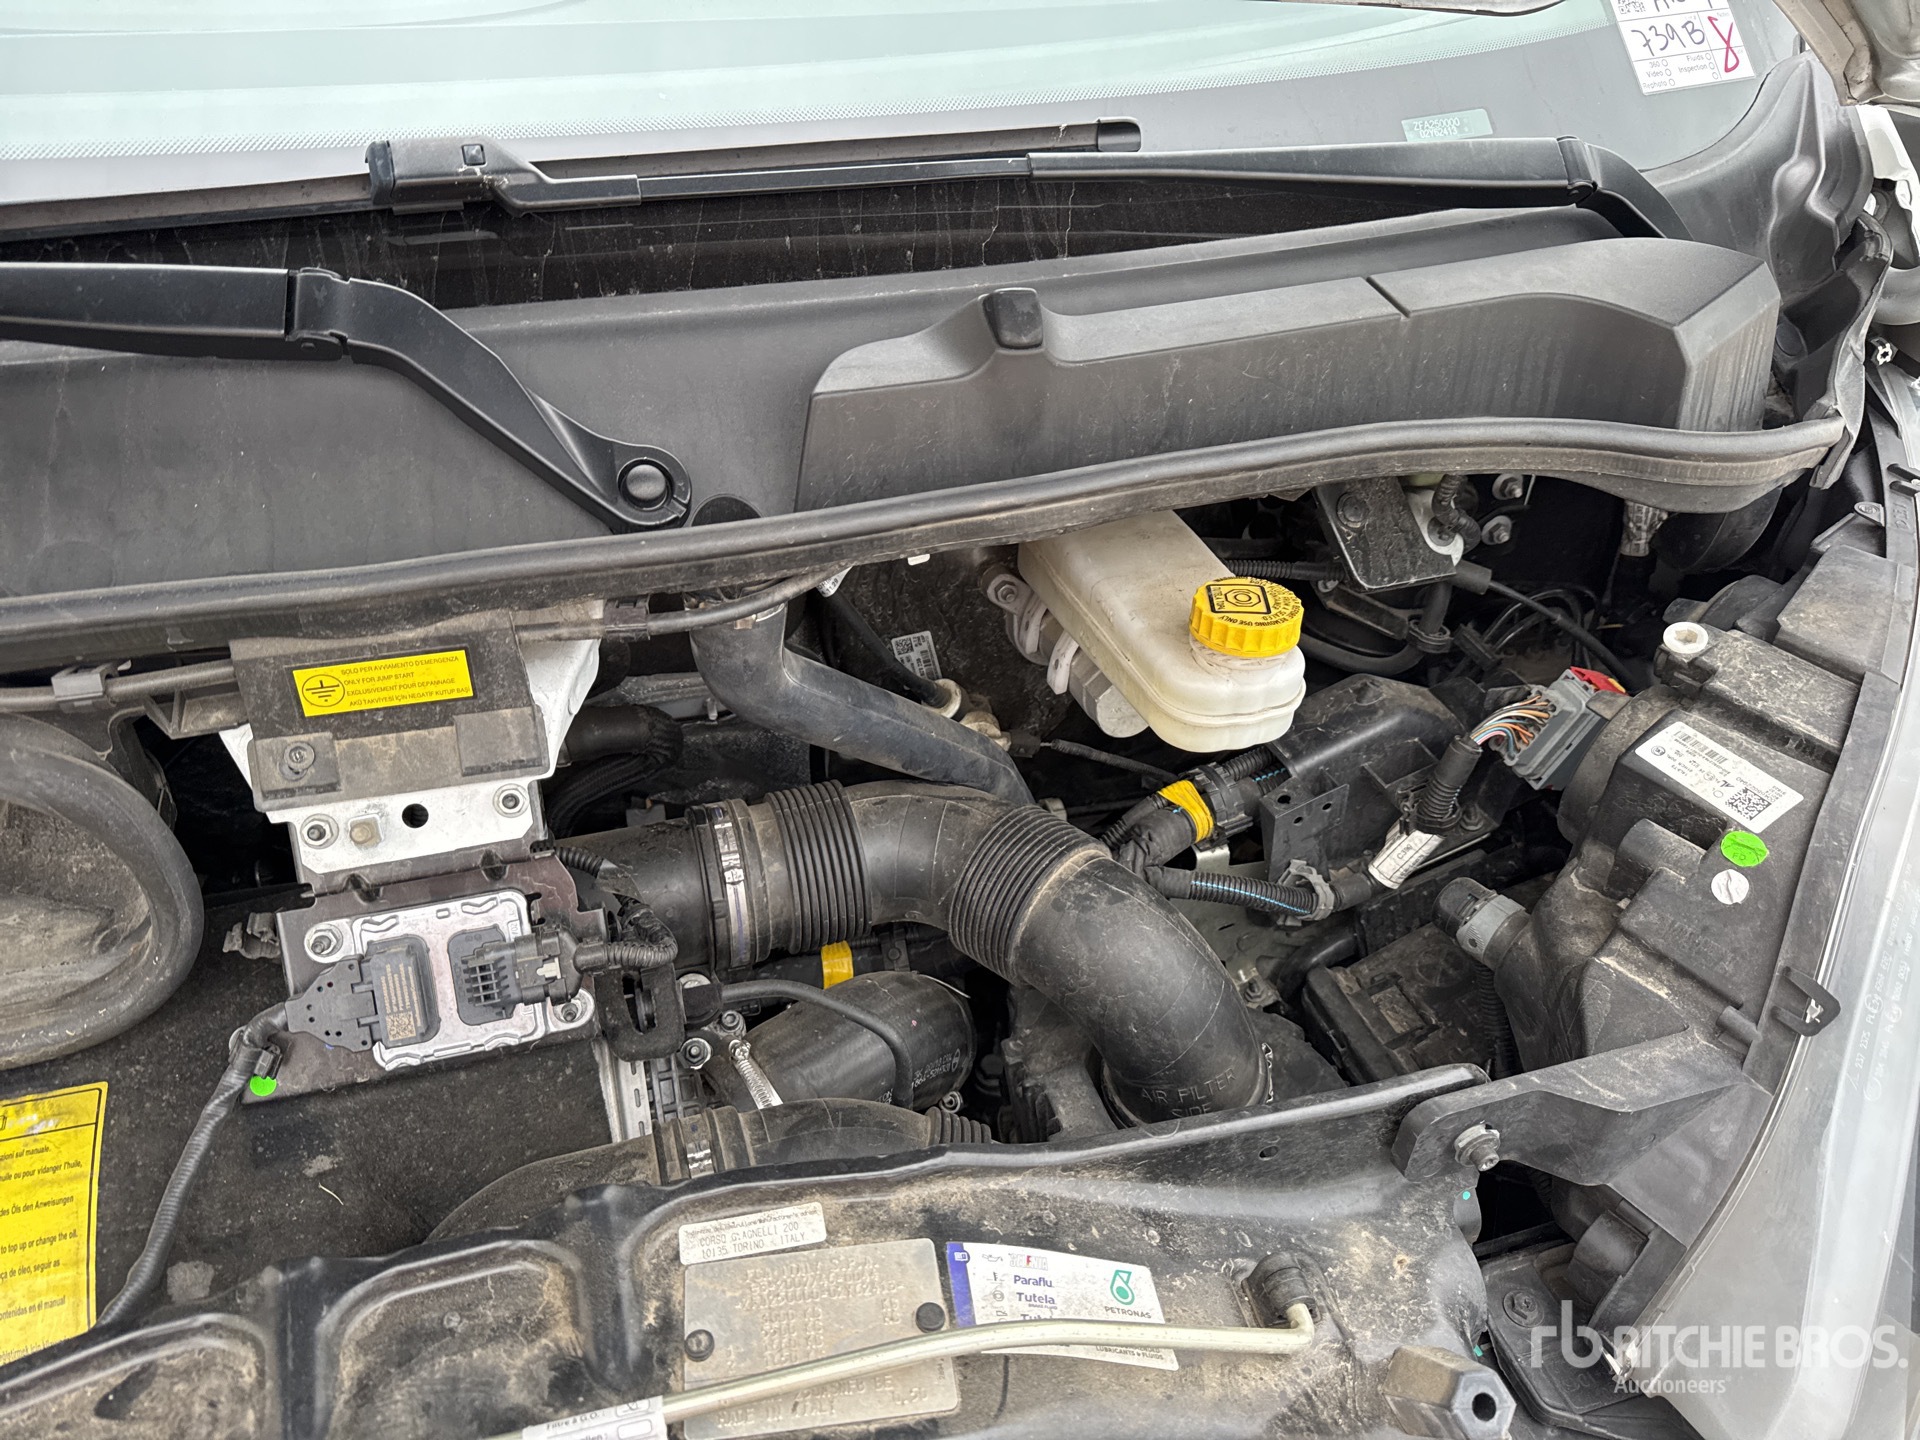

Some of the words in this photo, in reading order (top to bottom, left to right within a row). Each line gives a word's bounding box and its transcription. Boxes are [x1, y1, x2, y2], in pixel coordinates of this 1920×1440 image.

[1646, 70, 1664, 78] Video
[1678, 64, 1708, 73] Inspection
[1218, 615, 1238, 624] ONLY
[341, 667, 359, 675] SOLO
[359, 665, 373, 674] PER
[373, 660, 414, 672] AVVIAMENTO
[415, 655, 460, 667] D'EMERGENZA
[343, 677, 361, 686] ONLY
[361, 675, 375, 684] FOR
[376, 673, 393, 682] JUMP
[394, 672, 414, 680] START
[346, 685, 398, 697] EXCLUSIVEMENT
[398, 682, 417, 691] POUR
[417, 678, 455, 688] DEPANNAGE
[434, 687, 455, 697] KUTUP
[1142, 1087, 1168, 1104] AIR
[1177, 1067, 1237, 1103] FILTER
[1171, 1102, 1212, 1118] SIDE
[15, 1149, 25, 1158] sul
[25, 1145, 51, 1155] manuale.
[22, 1169, 36, 1179] pour
[37, 1164, 62, 1175] vidanger
[22, 1203, 34, 1212] den
[35, 1195, 74, 1209] Anweisungen
[700, 1234, 727, 1248] CORSO
[783, 1221, 799, 1233] 200
[0, 1245, 7, 1254] to
[8, 1243, 18, 1254] top
[19, 1241, 27, 1252] up
[28, 1240, 35, 1248] or
[36, 1236, 57, 1246] change
[58, 1232, 68, 1241] the
[701, 1245, 728, 1259] 10135
[733, 1239, 765, 1253] TORINO
[780, 1232, 806, 1245] ITALY
[9, 1268, 17, 1278] de
[33, 1260, 52, 1273] seguir
[53, 1259, 60, 1268] as
[1013, 1274, 1053, 1288] Paraflu
[28, 1304, 36, 1313] en
[37, 1301, 43, 1311] el
[44, 1295, 66, 1309] manual
[1016, 1292, 1056, 1305] Tutela
[1104, 1305, 1152, 1319] PETRONAS
[1096, 1345, 1135, 1356] LUBRICANTS
[1141, 1351, 1164, 1360] FLUIDS
